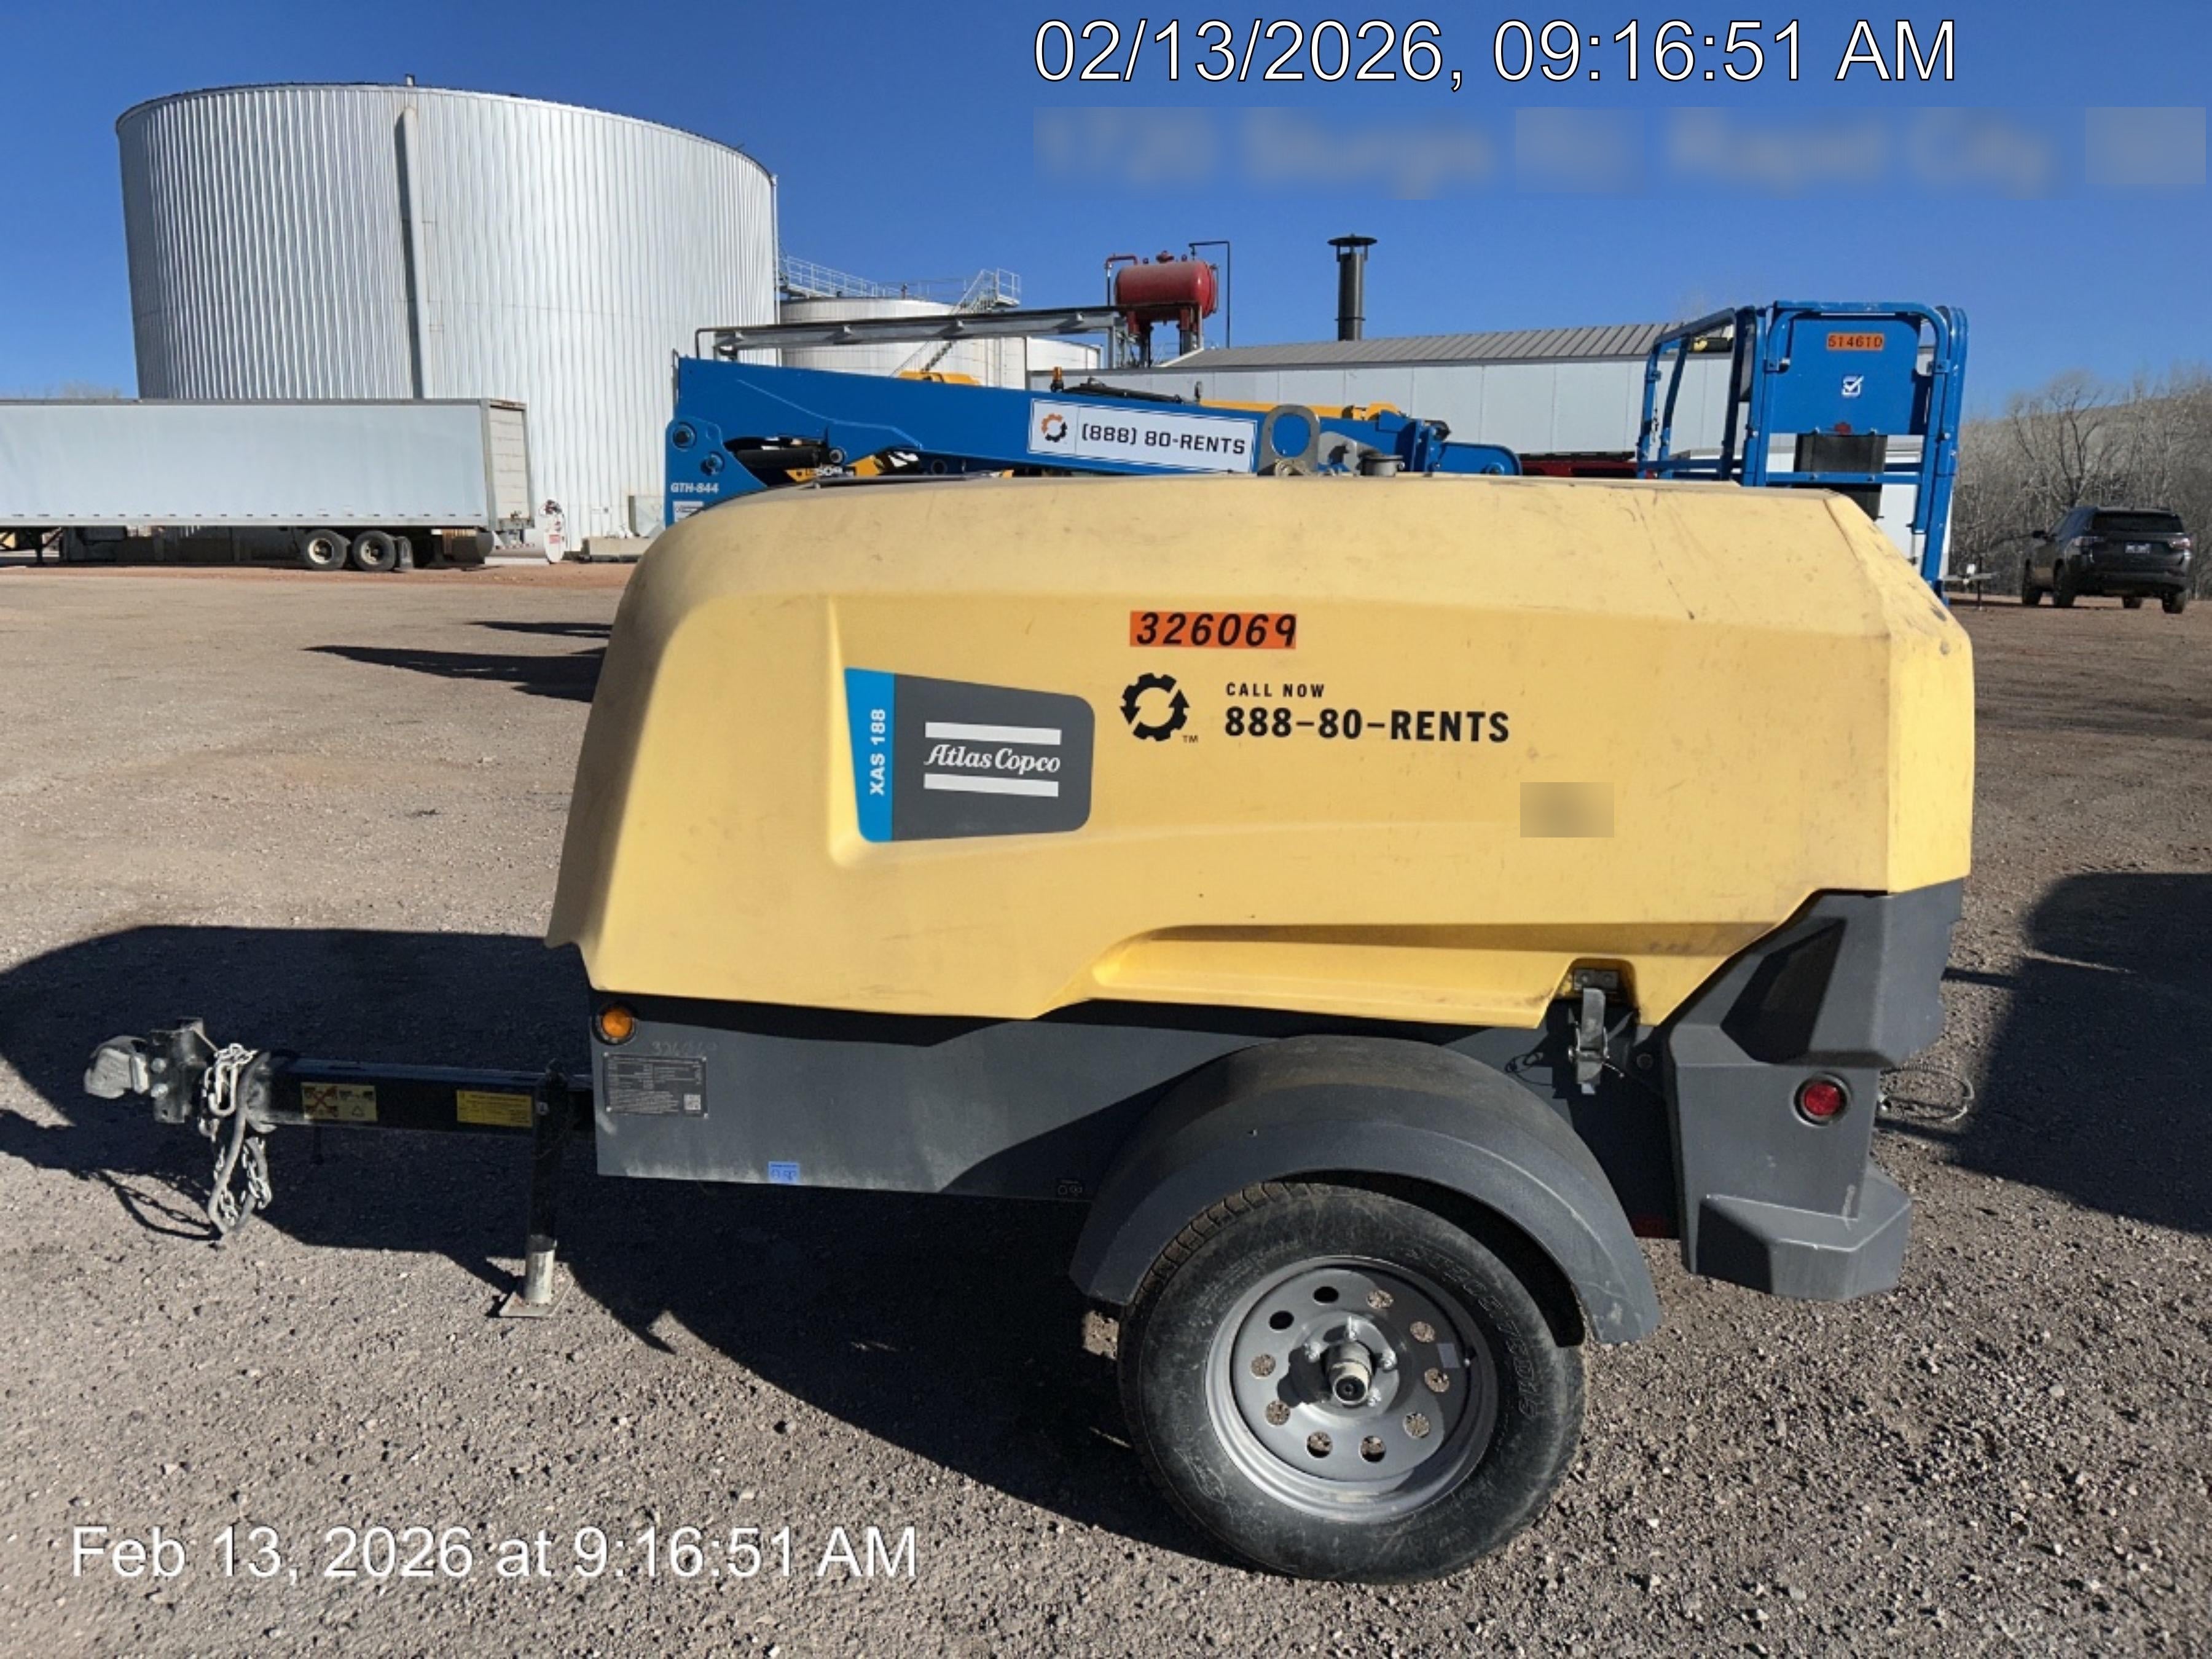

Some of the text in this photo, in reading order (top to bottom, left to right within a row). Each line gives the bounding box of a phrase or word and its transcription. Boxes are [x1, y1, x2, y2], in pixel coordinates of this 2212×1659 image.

[1081, 423, 1245, 455] (888) 80-RENTS
[671, 482, 719, 494] GTH-844
[1137, 611, 1296, 648] 326069
[1226, 682, 1325, 698] CALL NOW
[1225, 705, 1510, 742] 888-80-RENTS
[869, 709, 886, 796] XAS 188
[924, 743, 1062, 775] Atlas Copco
